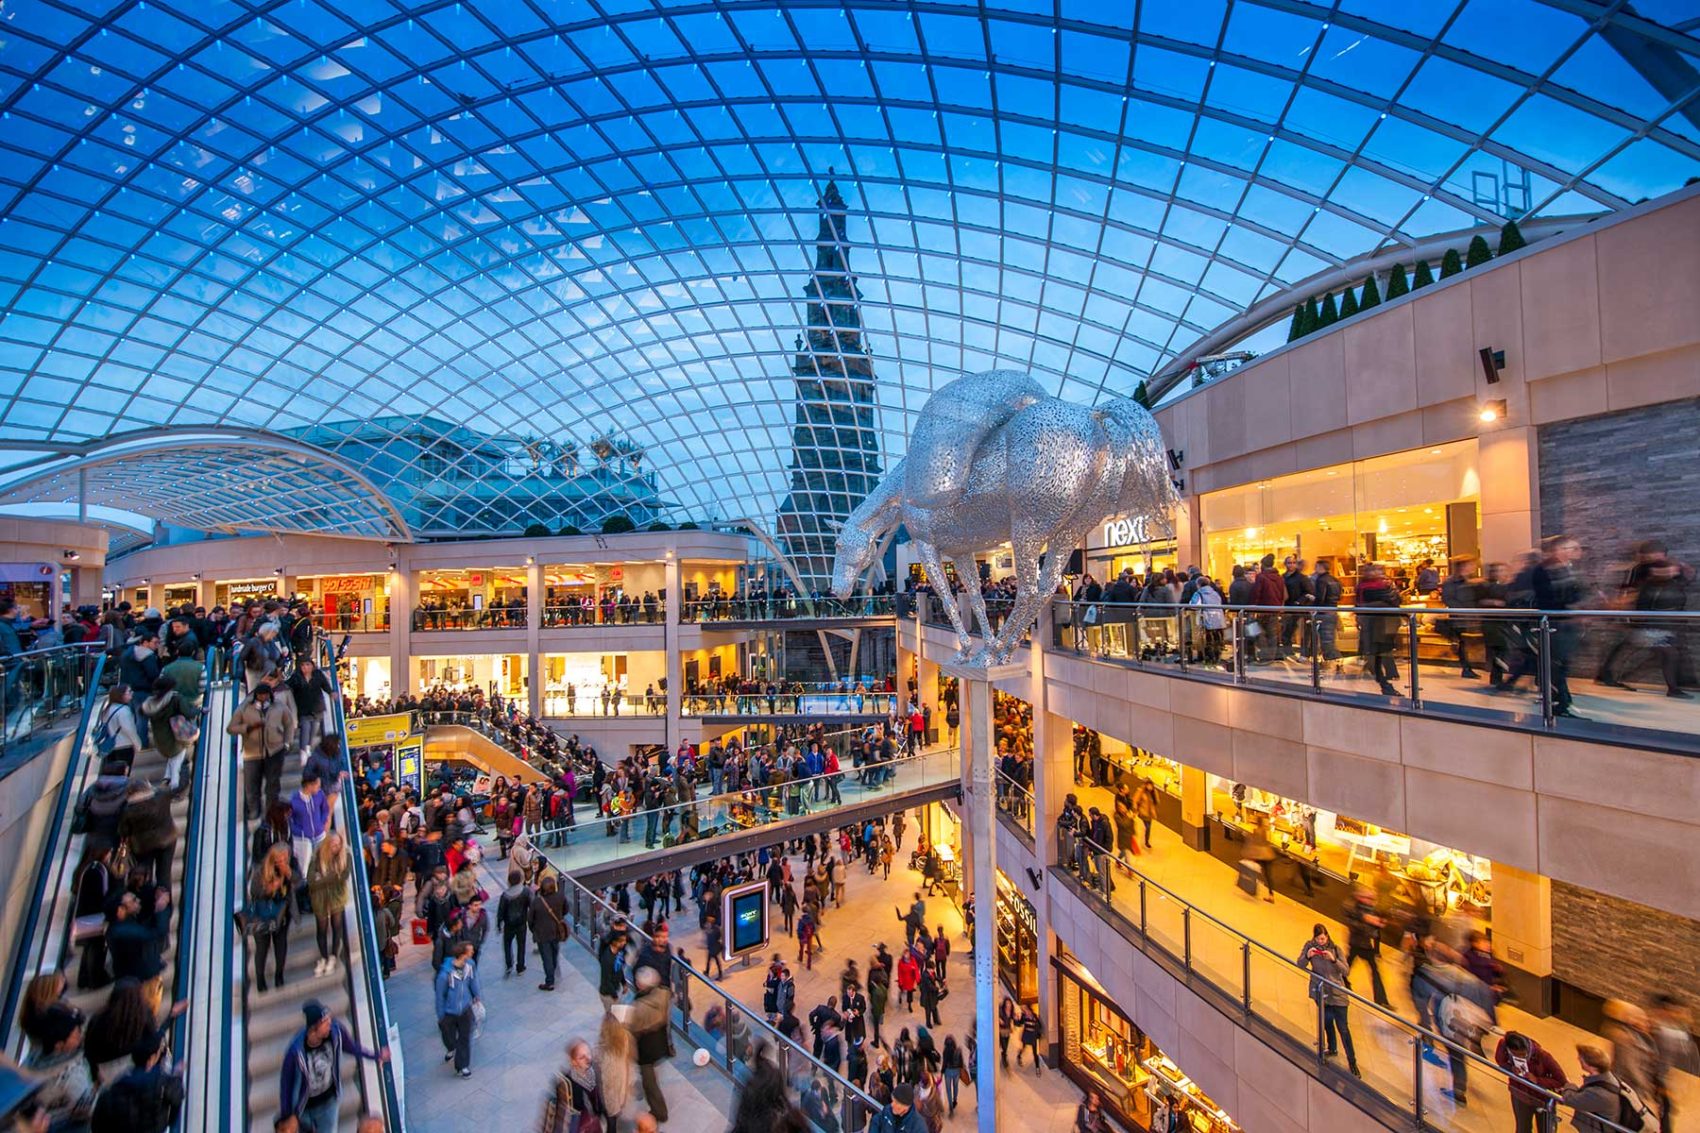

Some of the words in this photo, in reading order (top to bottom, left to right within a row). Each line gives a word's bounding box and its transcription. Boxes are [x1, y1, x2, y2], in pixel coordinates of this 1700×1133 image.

[1104, 516, 1150, 547] next
[251, 583, 268, 594] burger
[1009, 891, 1037, 937] FOSSIL
